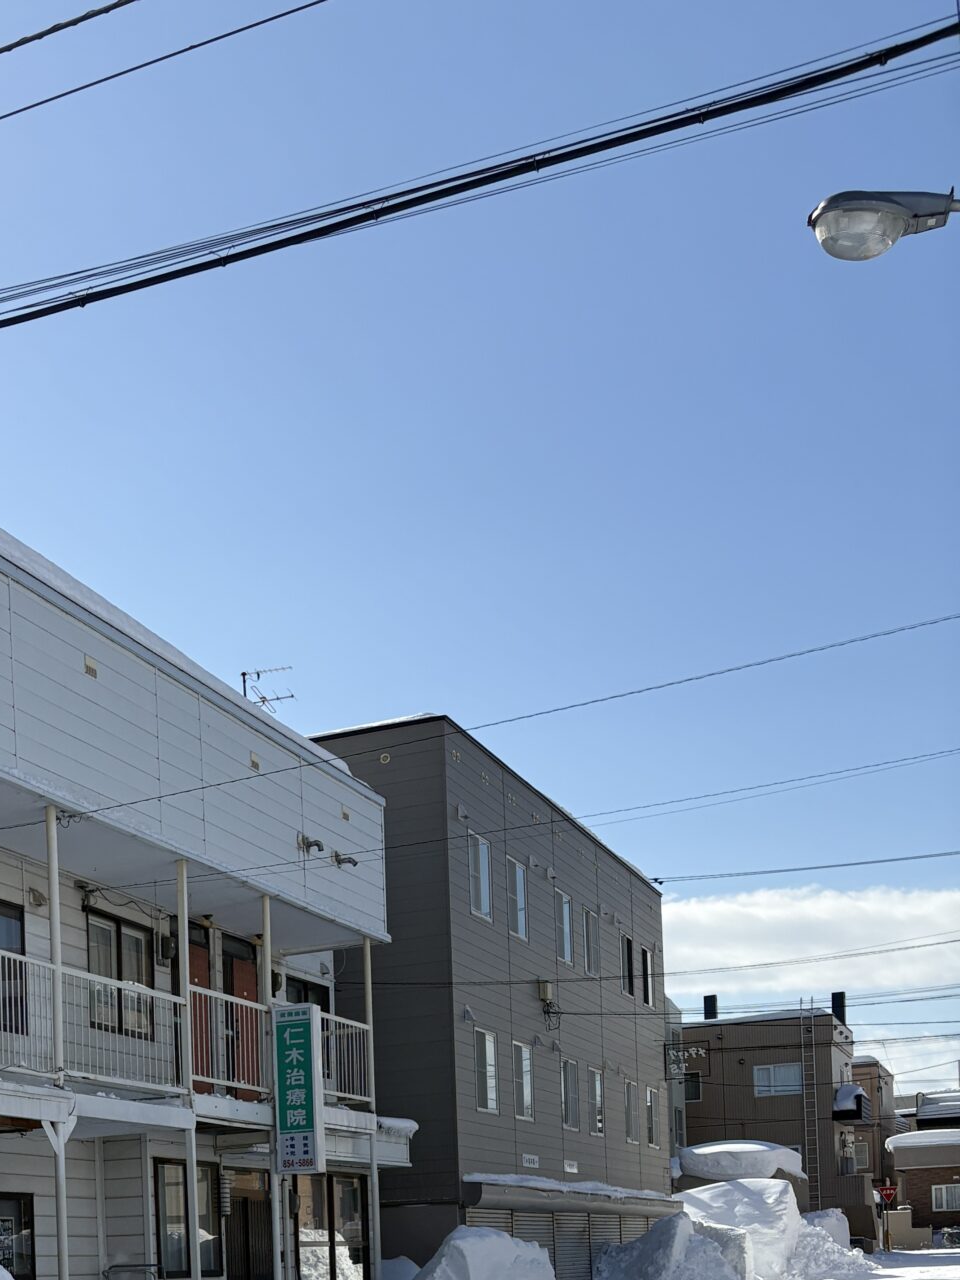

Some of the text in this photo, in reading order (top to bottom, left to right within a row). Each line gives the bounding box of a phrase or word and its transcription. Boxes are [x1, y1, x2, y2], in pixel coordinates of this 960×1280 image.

[284, 1028, 306, 1127] 仁木治療院
